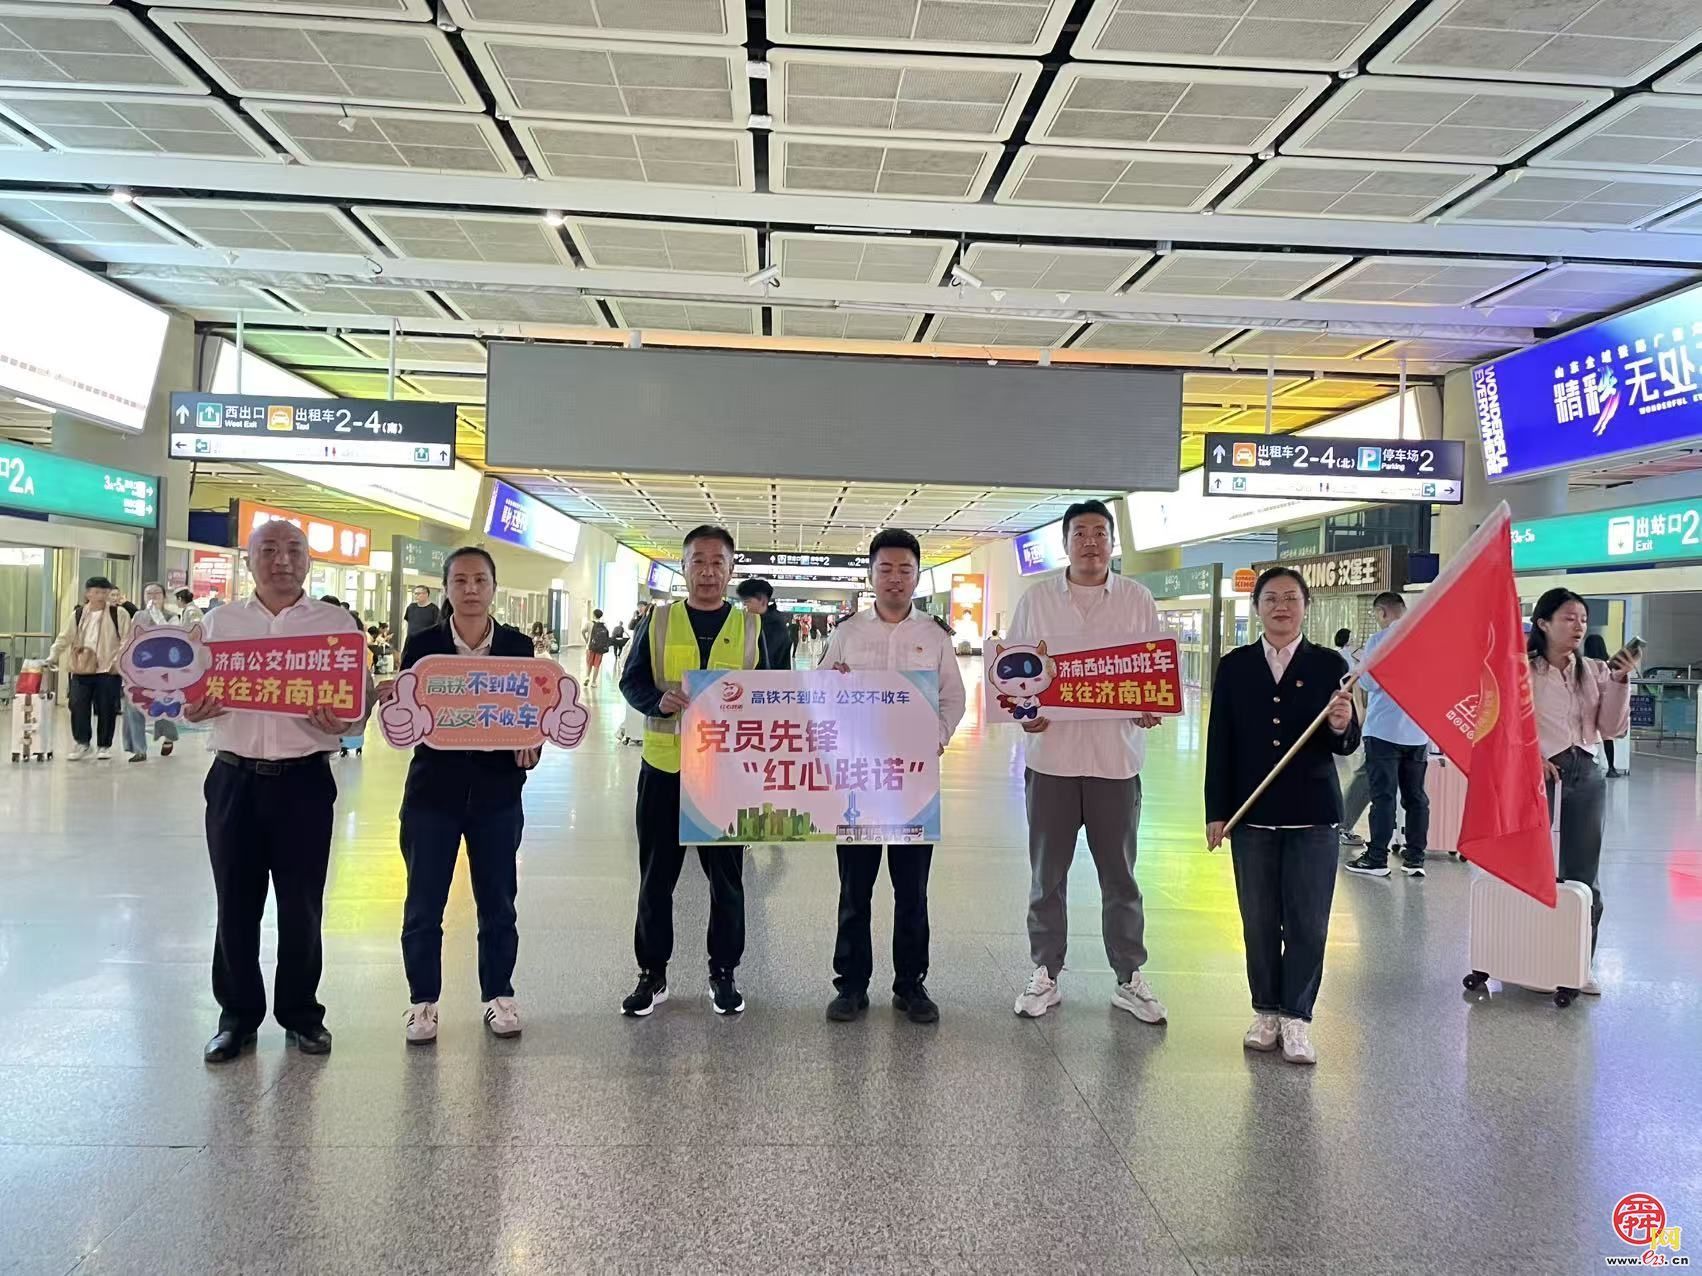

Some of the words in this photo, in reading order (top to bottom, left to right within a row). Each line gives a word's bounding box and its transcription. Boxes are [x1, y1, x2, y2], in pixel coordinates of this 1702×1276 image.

[1554, 344, 1702, 437] 精彩无处
[225, 405, 265, 419] 西出口
[1381, 462, 1406, 471] Parking
[1635, 539, 1654, 552] Exit
[1303, 560, 1336, 588] KING
[1338, 557, 1375, 586] 汉堡王
[214, 646, 358, 672] 济南公交加班车
[1059, 649, 1175, 678] 济南西站加班车
[205, 676, 354, 710] 发往济南站
[426, 671, 531, 698] 高铁不到站
[751, 690, 826, 705] 高铁不到站
[836, 690, 911, 705] 公交不收车
[1059, 679, 1176, 707] 发往济南站
[436, 704, 540, 730] 公交不收车
[696, 719, 839, 753] 党员先锋
